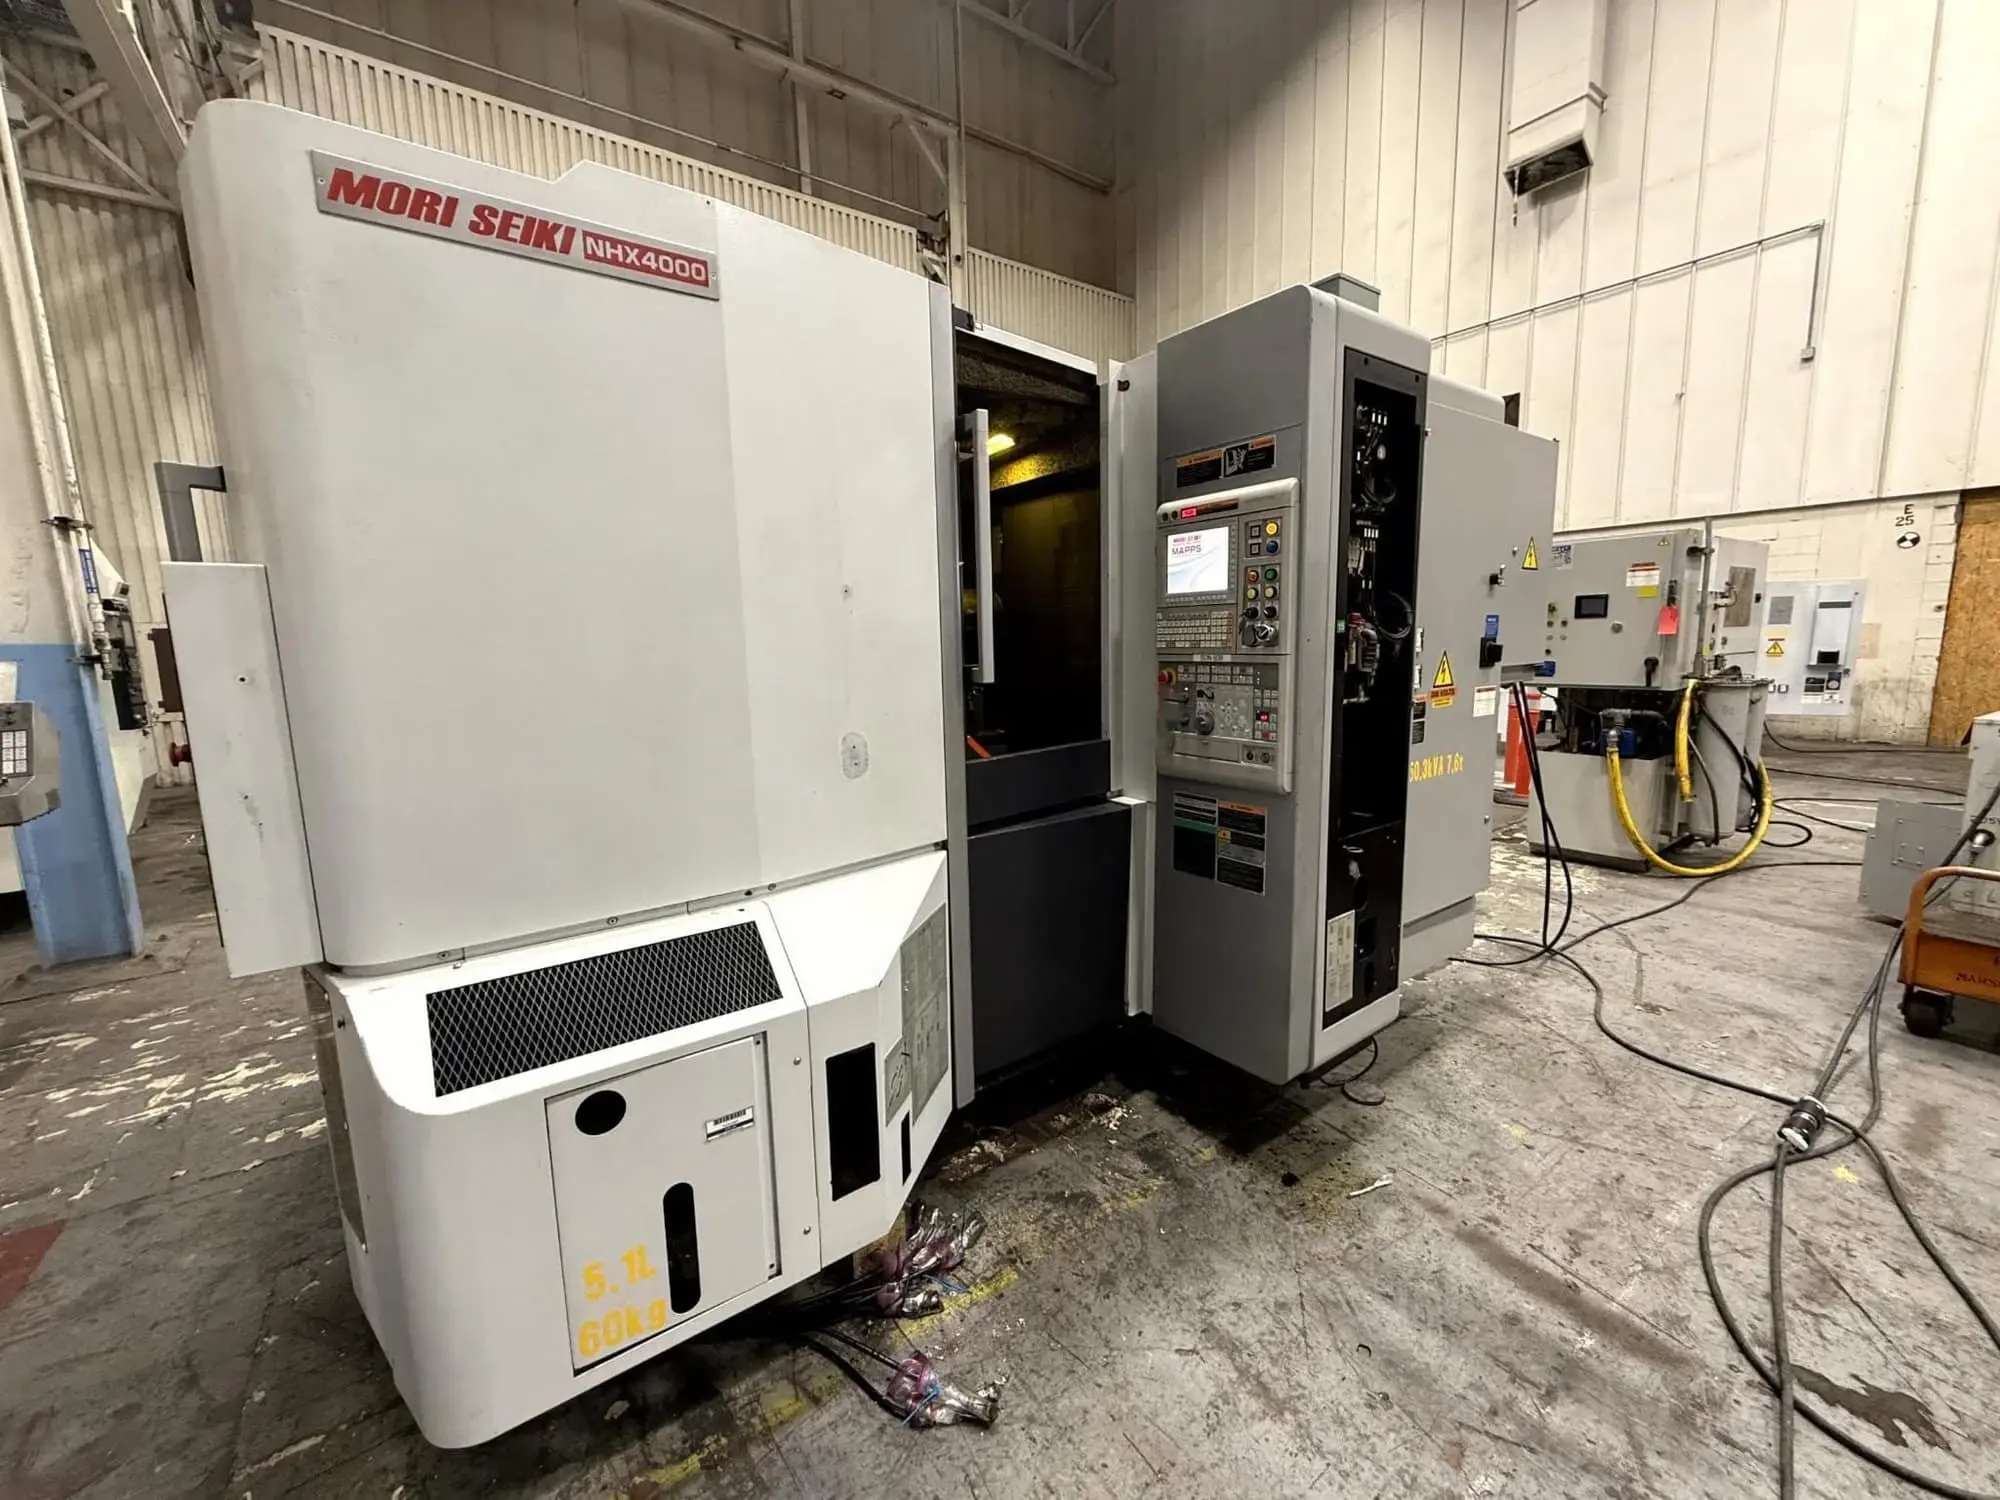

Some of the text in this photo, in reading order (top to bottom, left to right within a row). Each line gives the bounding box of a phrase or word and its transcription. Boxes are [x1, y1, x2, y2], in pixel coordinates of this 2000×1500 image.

[327, 167, 706, 281] MORI SEIKI NHX4000
[1904, 503, 1914, 514] E
[1895, 514, 1914, 527] 25
[1172, 544, 1202, 555] MAPPS
[578, 1298, 667, 1357] 60kg
